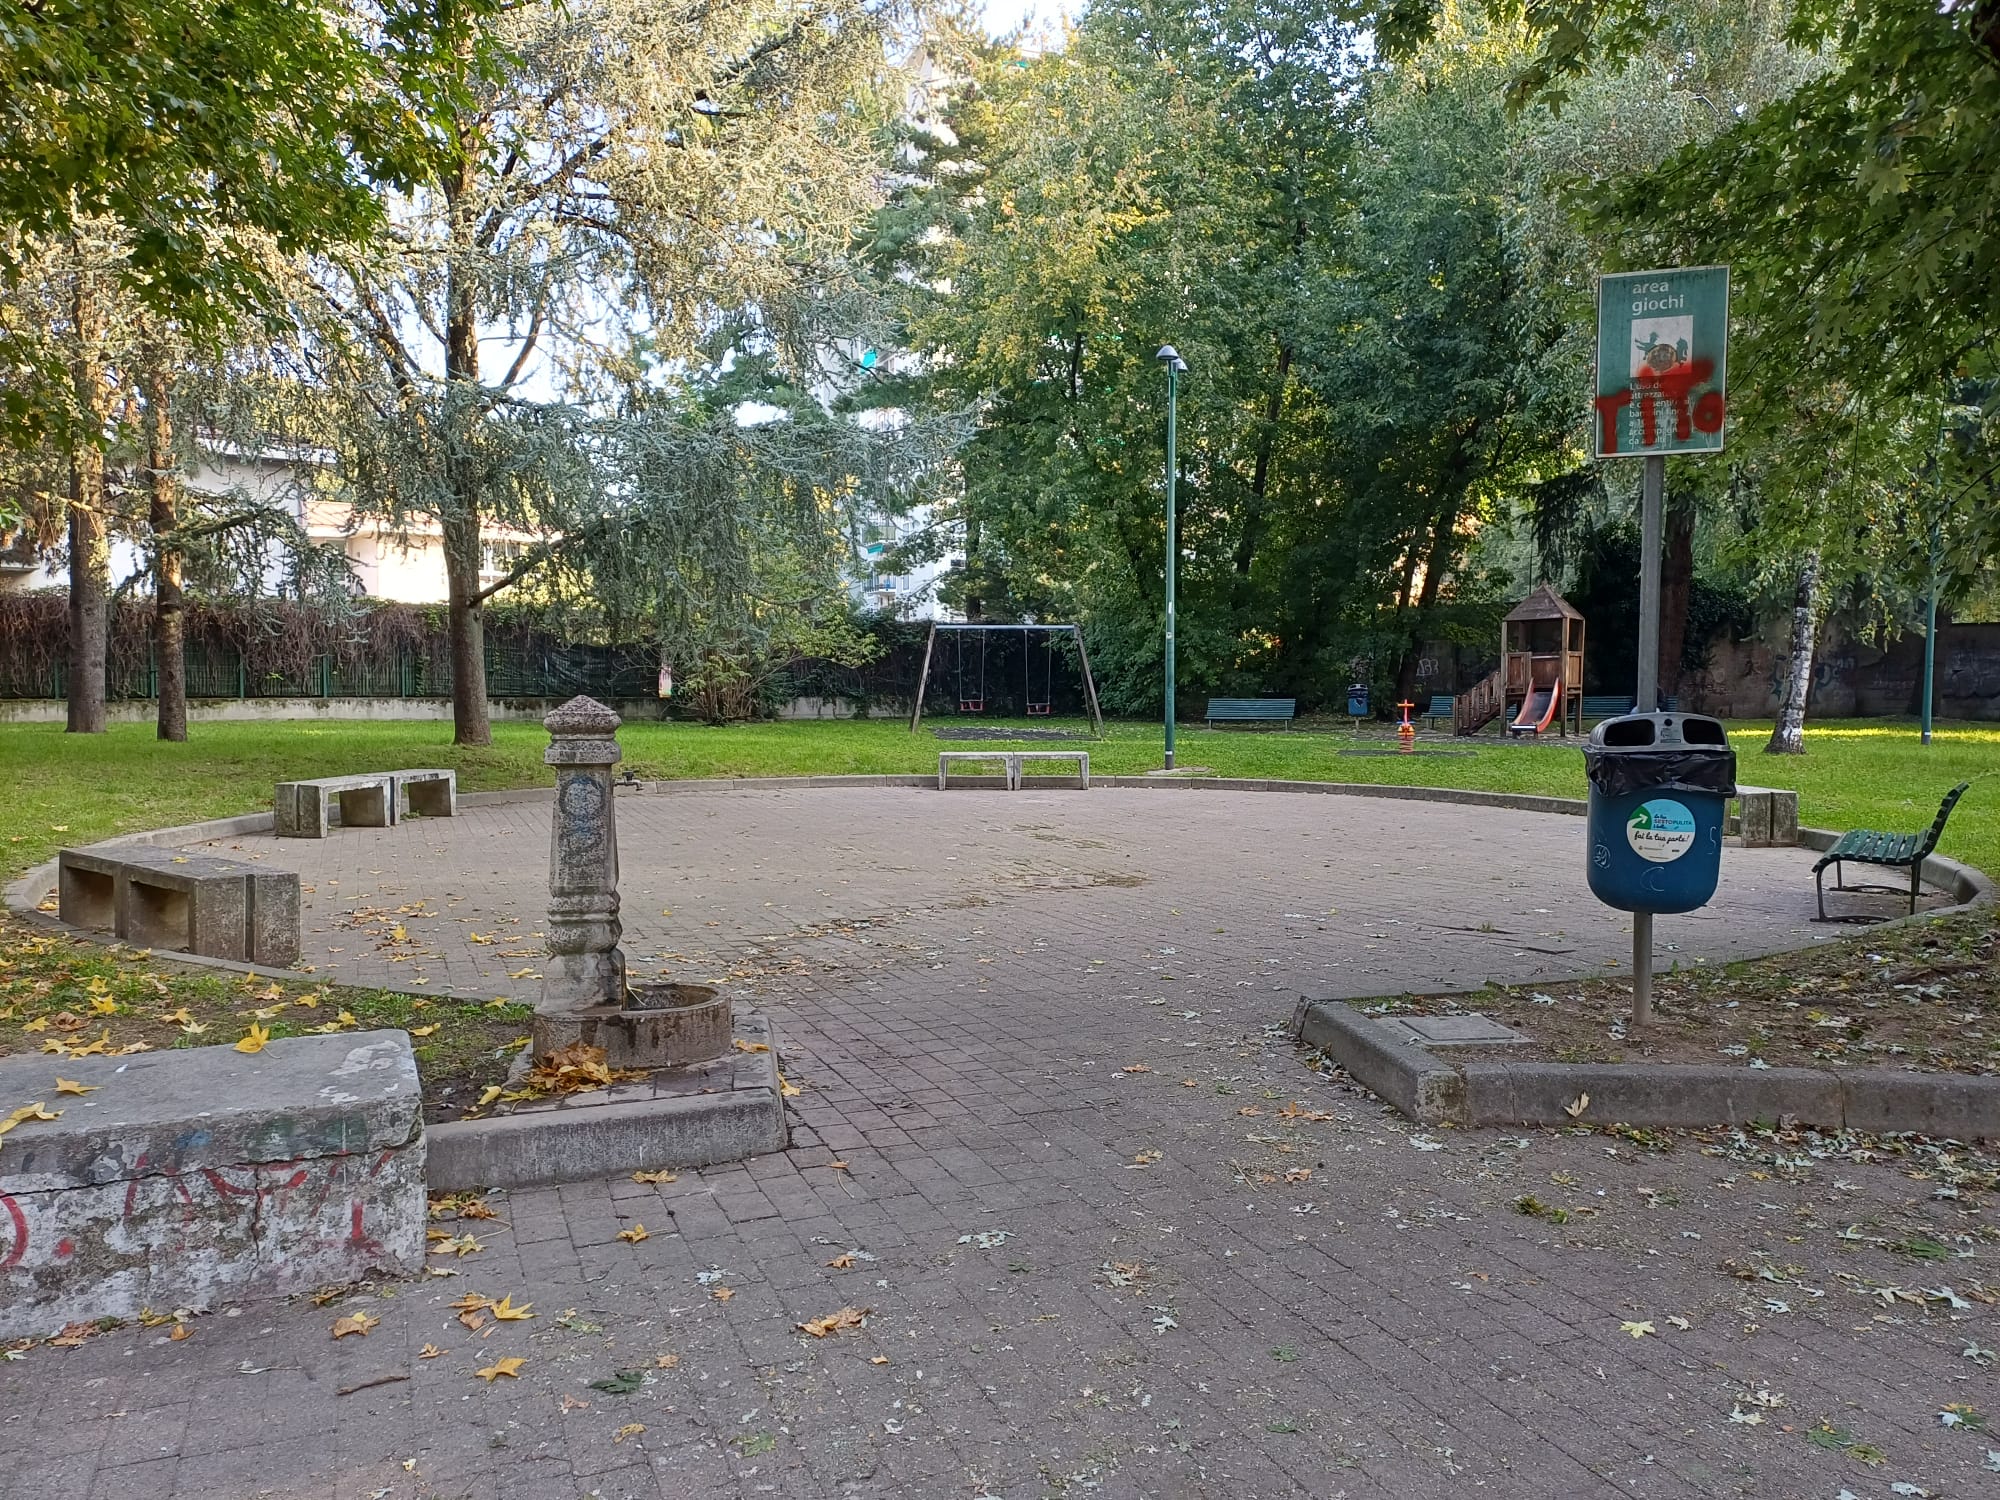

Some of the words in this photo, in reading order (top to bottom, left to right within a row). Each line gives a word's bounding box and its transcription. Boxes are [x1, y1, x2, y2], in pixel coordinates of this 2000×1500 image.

[1632, 281, 1669, 294] area
[1632, 294, 1684, 315] giochi
[1634, 831, 1644, 840] fai
[1645, 832, 1653, 840] la
[1654, 833, 1666, 841] tua
[1666, 835, 1690, 844] parte!
